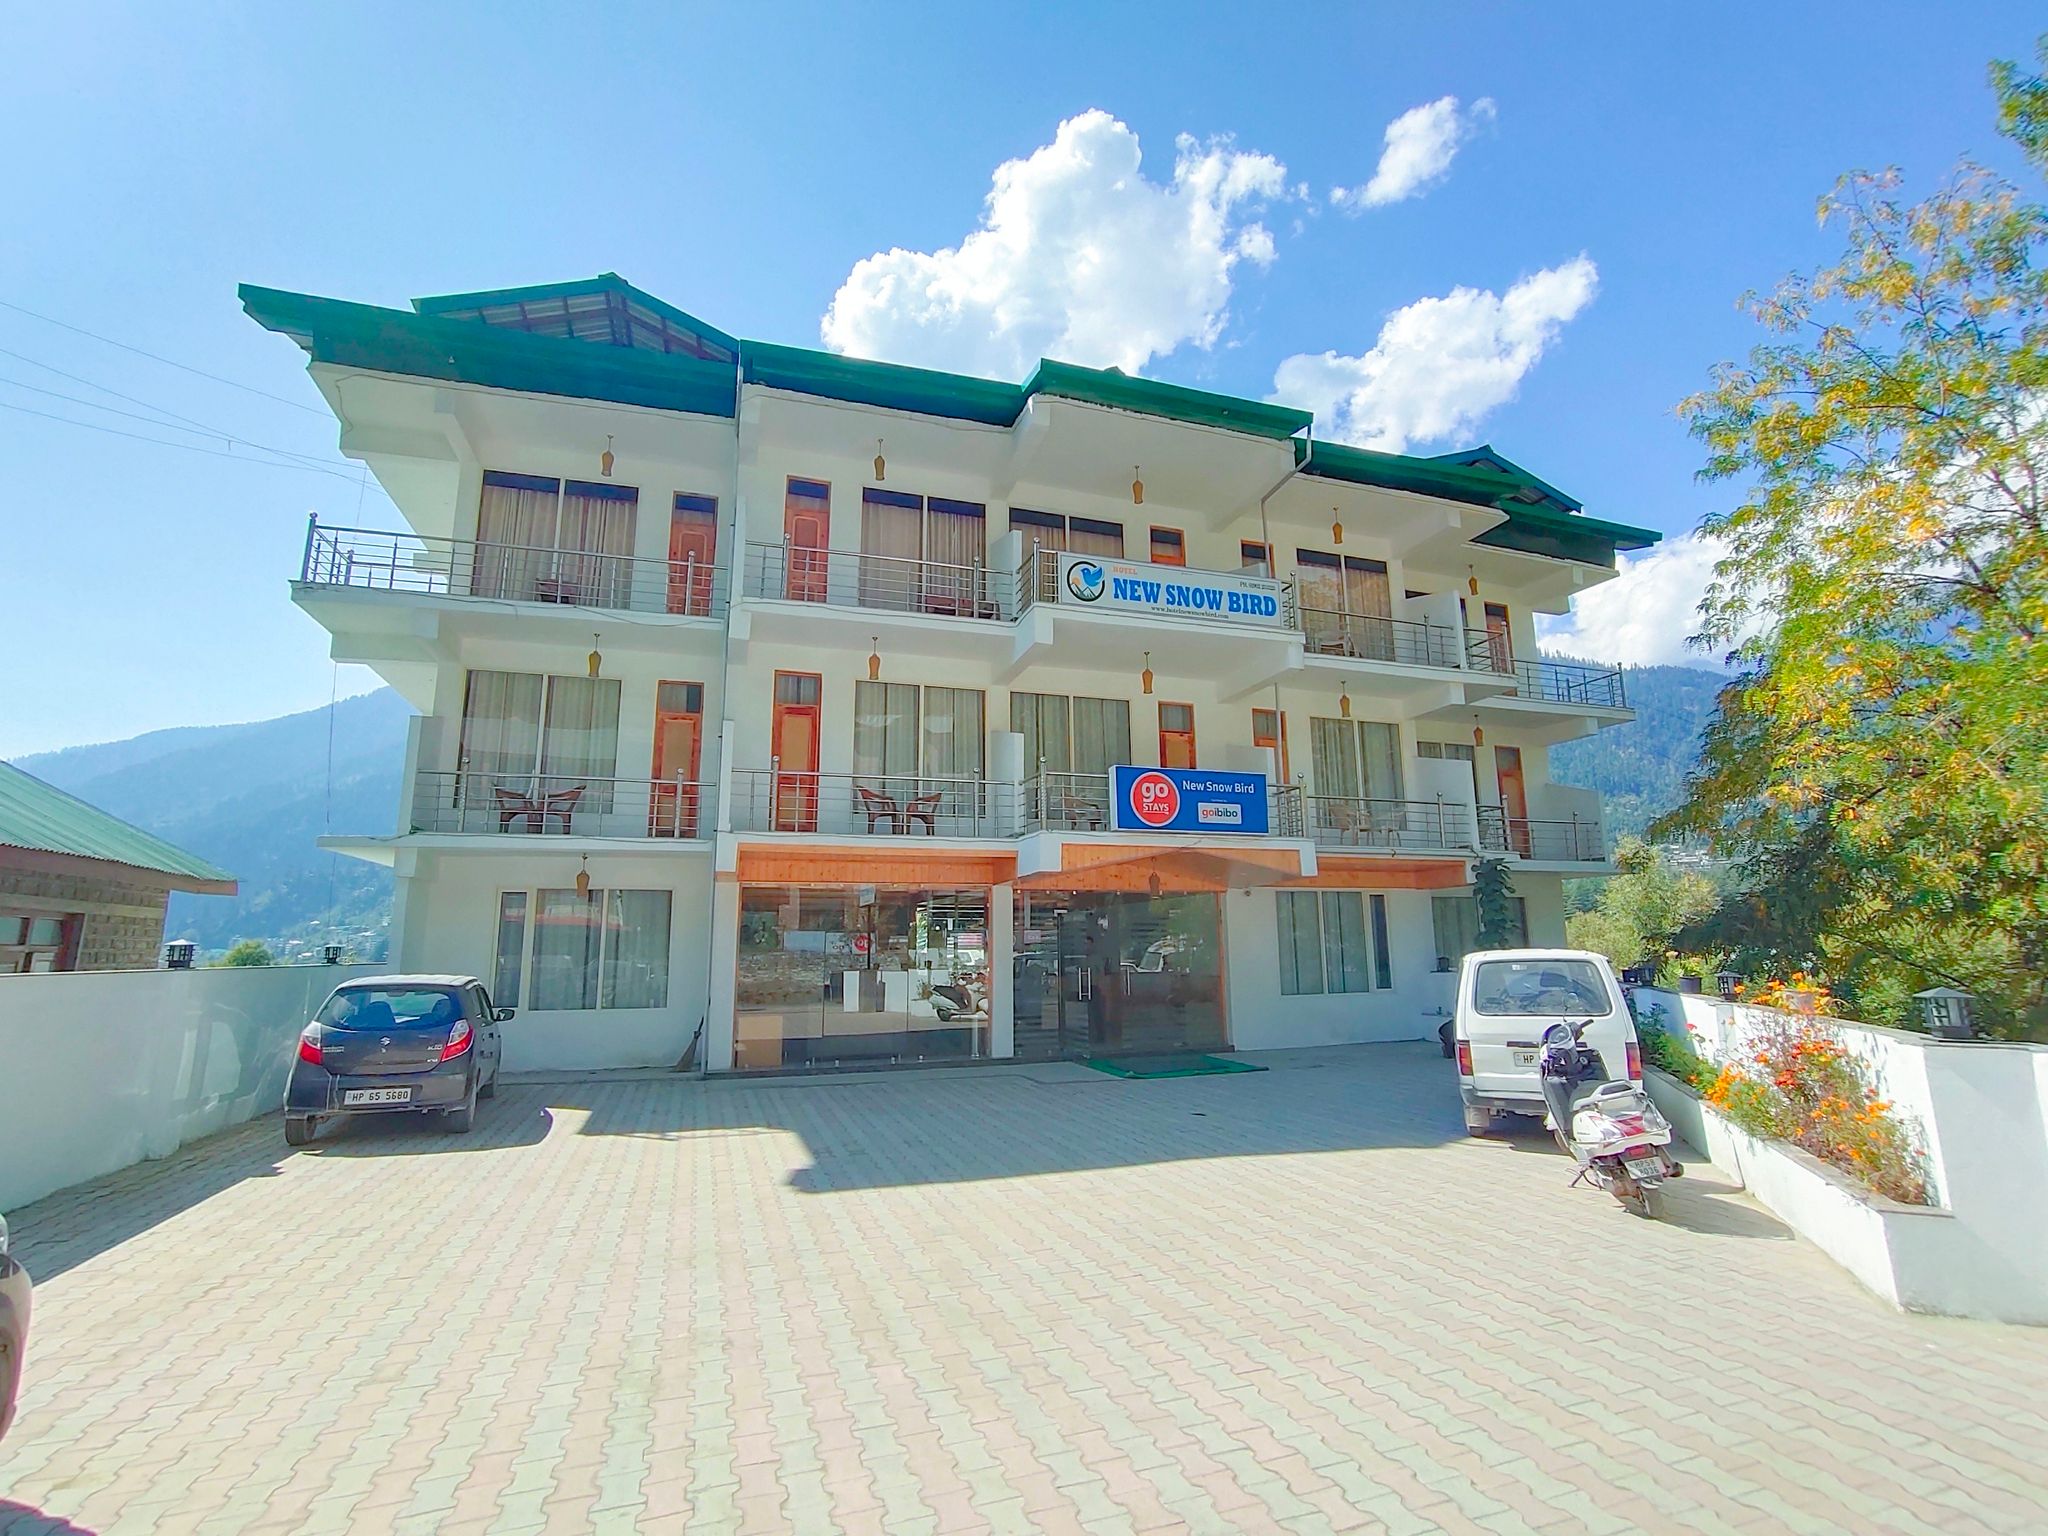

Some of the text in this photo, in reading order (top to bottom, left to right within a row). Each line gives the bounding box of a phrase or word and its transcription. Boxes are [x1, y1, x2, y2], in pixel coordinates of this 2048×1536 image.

[1113, 567, 1138, 575] HOTEL
[1113, 577, 1277, 617] NEW SNOW BIRD
[1141, 782, 1169, 802] go
[1182, 780, 1254, 794] New Snow Bird
[1143, 803, 1169, 812] STAYS
[1202, 807, 1238, 819] goibibo
[1523, 1055, 1534, 1063] HP
[352, 1091, 409, 1102] HP 65 5680
